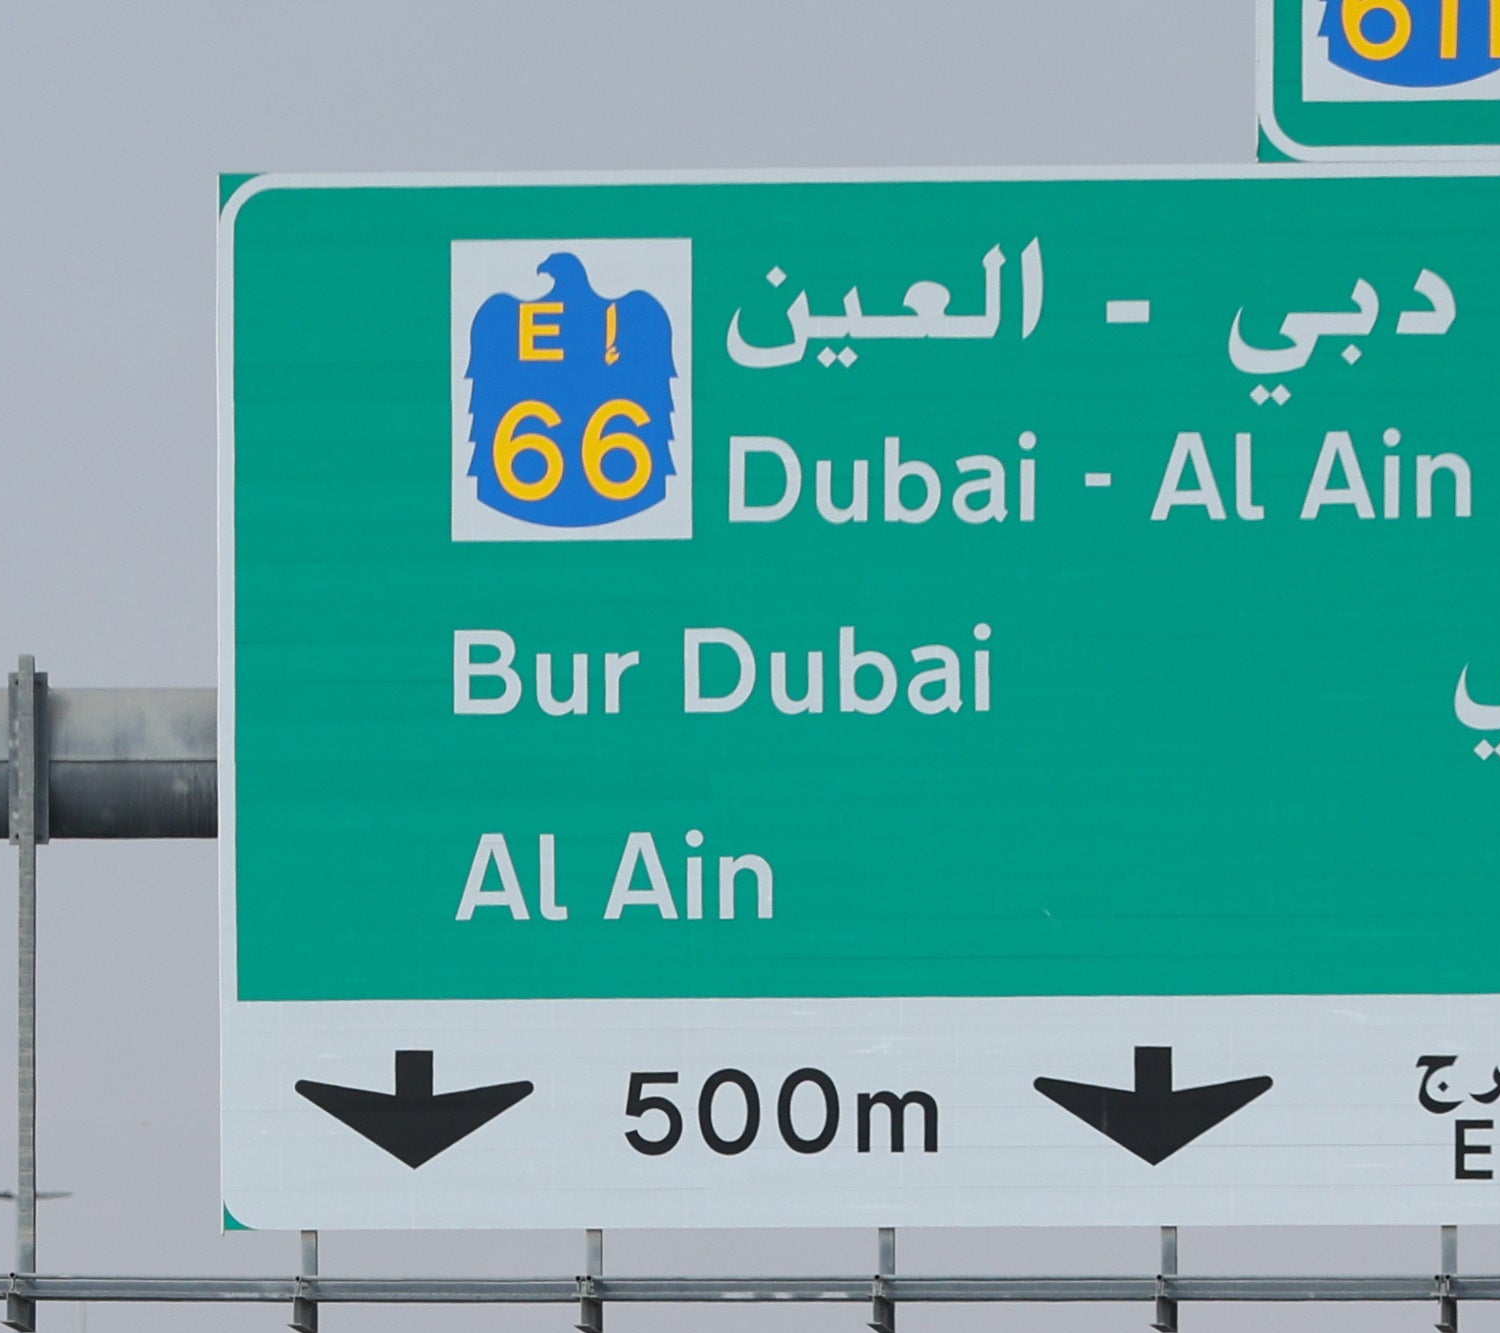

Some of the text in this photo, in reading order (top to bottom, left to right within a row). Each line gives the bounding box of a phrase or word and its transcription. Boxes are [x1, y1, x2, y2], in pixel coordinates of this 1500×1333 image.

[519, 303, 564, 360] E
[727, 237, 1043, 368] العين
[1107, 300, 1150, 323] -
[1229, 269, 1456, 405] دبي
[493, 400, 652, 500] 66
[729, 431, 1036, 523] Dubai
[1085, 473, 1111, 486] -
[1151, 432, 1264, 520] Al
[1301, 428, 1471, 519] Ain
[454, 623, 991, 716] Bur Dubai
[456, 830, 773, 920] Al Ain
[625, 1068, 937, 1155] 500m
